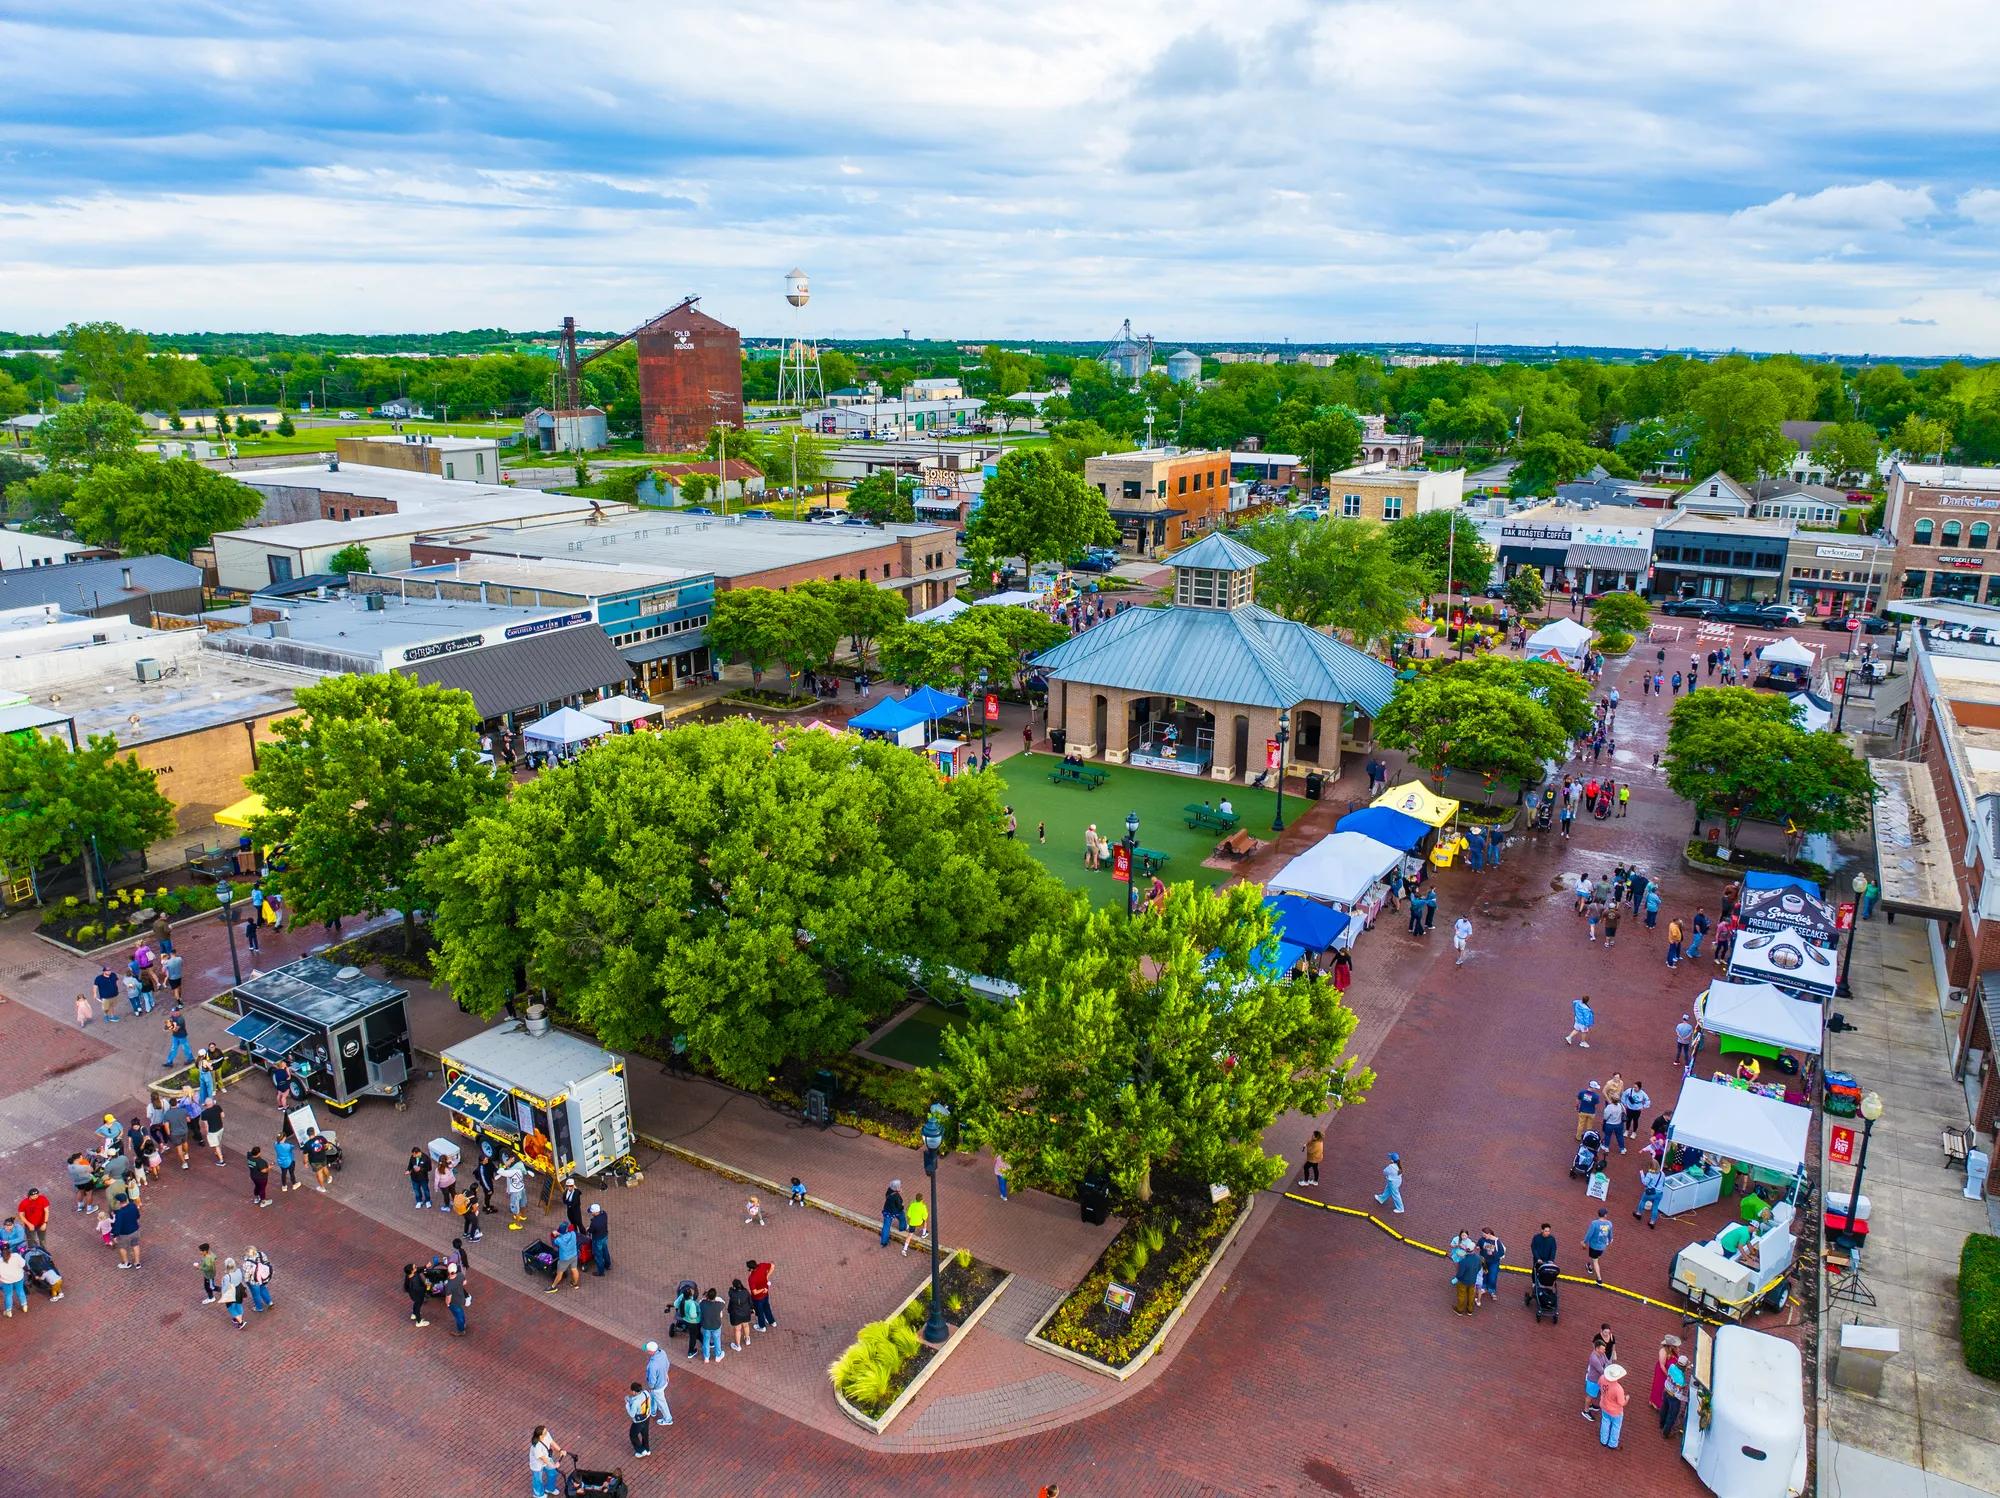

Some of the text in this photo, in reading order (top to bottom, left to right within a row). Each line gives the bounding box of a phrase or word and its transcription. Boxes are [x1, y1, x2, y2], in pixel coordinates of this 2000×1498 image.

[925, 469, 956, 480] BONGO
[1503, 528, 1570, 540] OAK ROASTED COFFEE
[409, 645, 442, 660] CHRISTY
[1767, 906, 1814, 926] Sweetie's
[1748, 917, 1780, 931] PREMIUM
